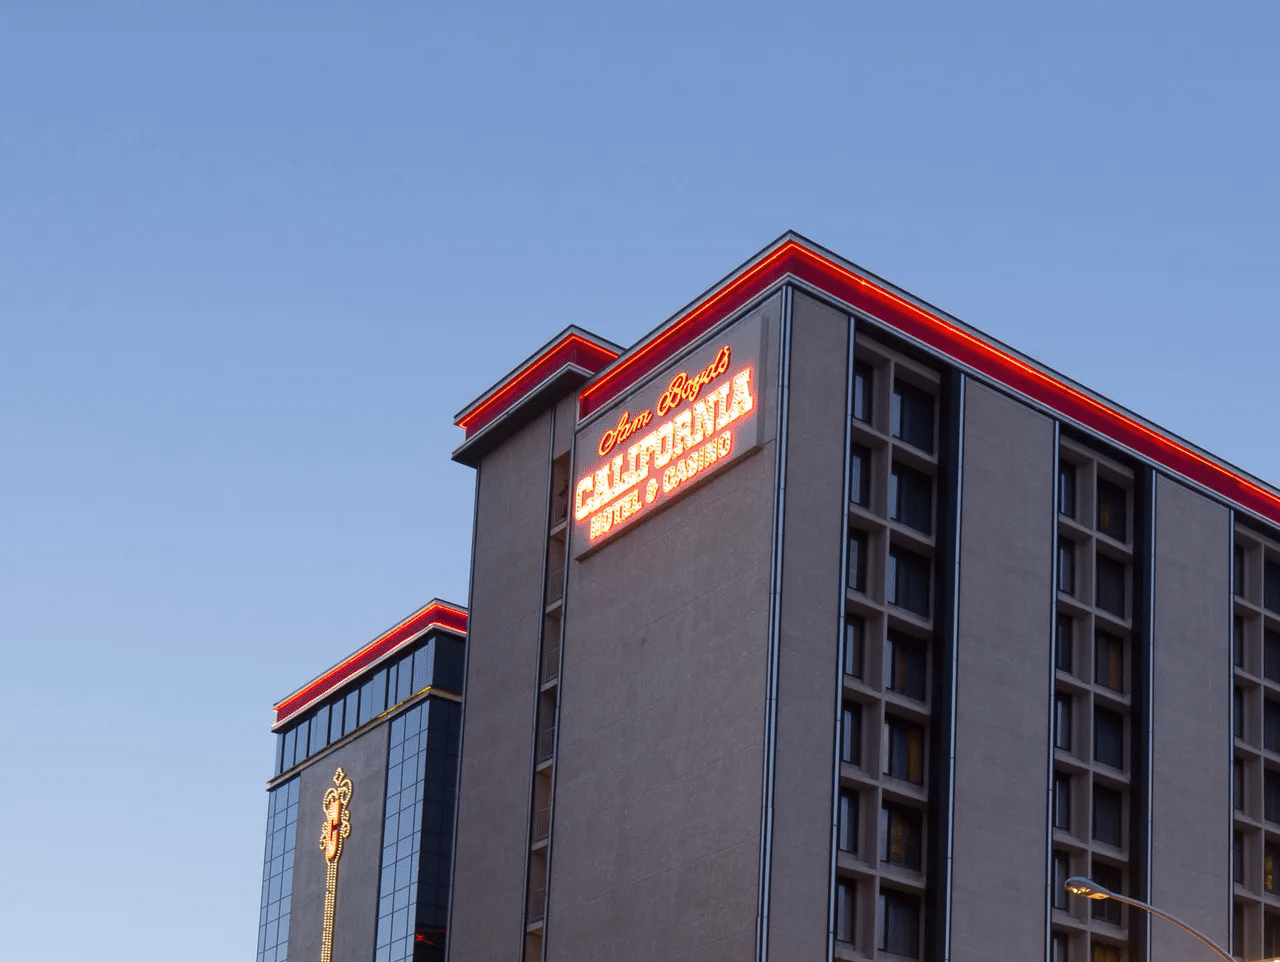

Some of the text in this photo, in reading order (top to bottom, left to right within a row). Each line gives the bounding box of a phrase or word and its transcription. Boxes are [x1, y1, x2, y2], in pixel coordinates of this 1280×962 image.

[575, 368, 754, 521] CALIFORNIA
[589, 430, 732, 540] HOTEL & CASINO
